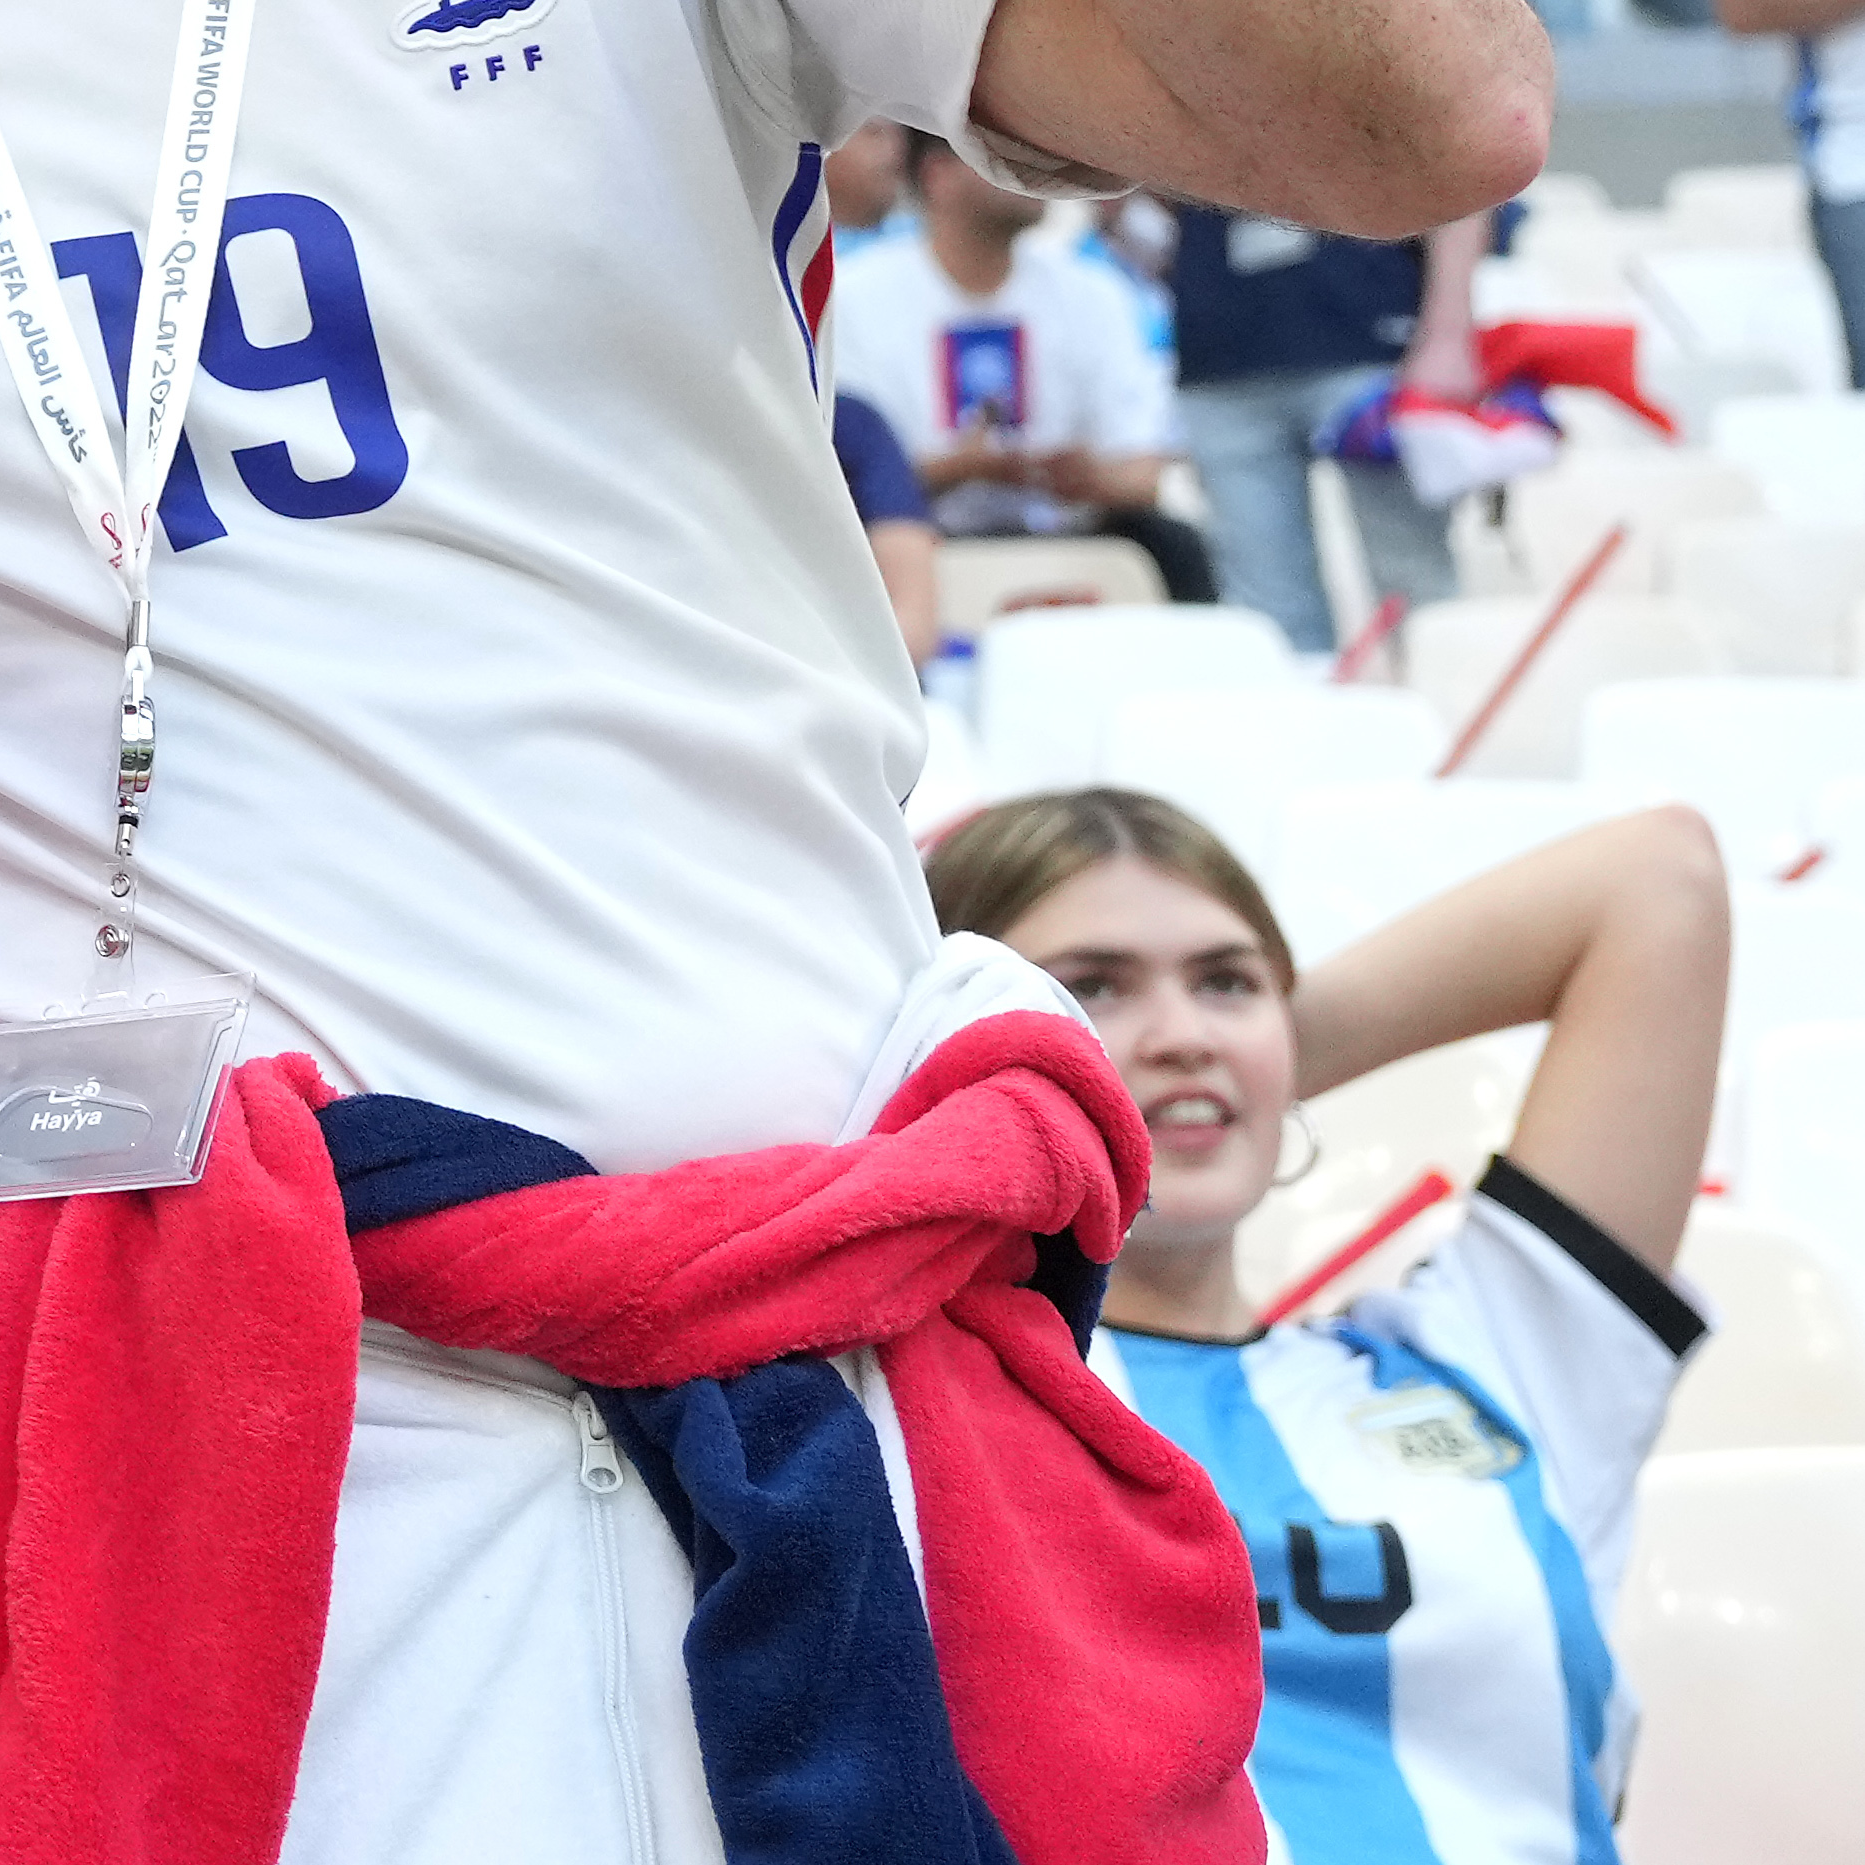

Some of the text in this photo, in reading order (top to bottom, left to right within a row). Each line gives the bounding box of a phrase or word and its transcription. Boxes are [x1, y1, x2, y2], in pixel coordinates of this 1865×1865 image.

[449, 44, 543, 91] FFF
[184, 61, 221, 163] WORLD
[175, 169, 203, 224] CUP
[7, 309, 62, 387] العالم
[49, 192, 410, 553] 19
[40, 393, 88, 464] كأس
[29, 1109, 103, 1132] Hayya
